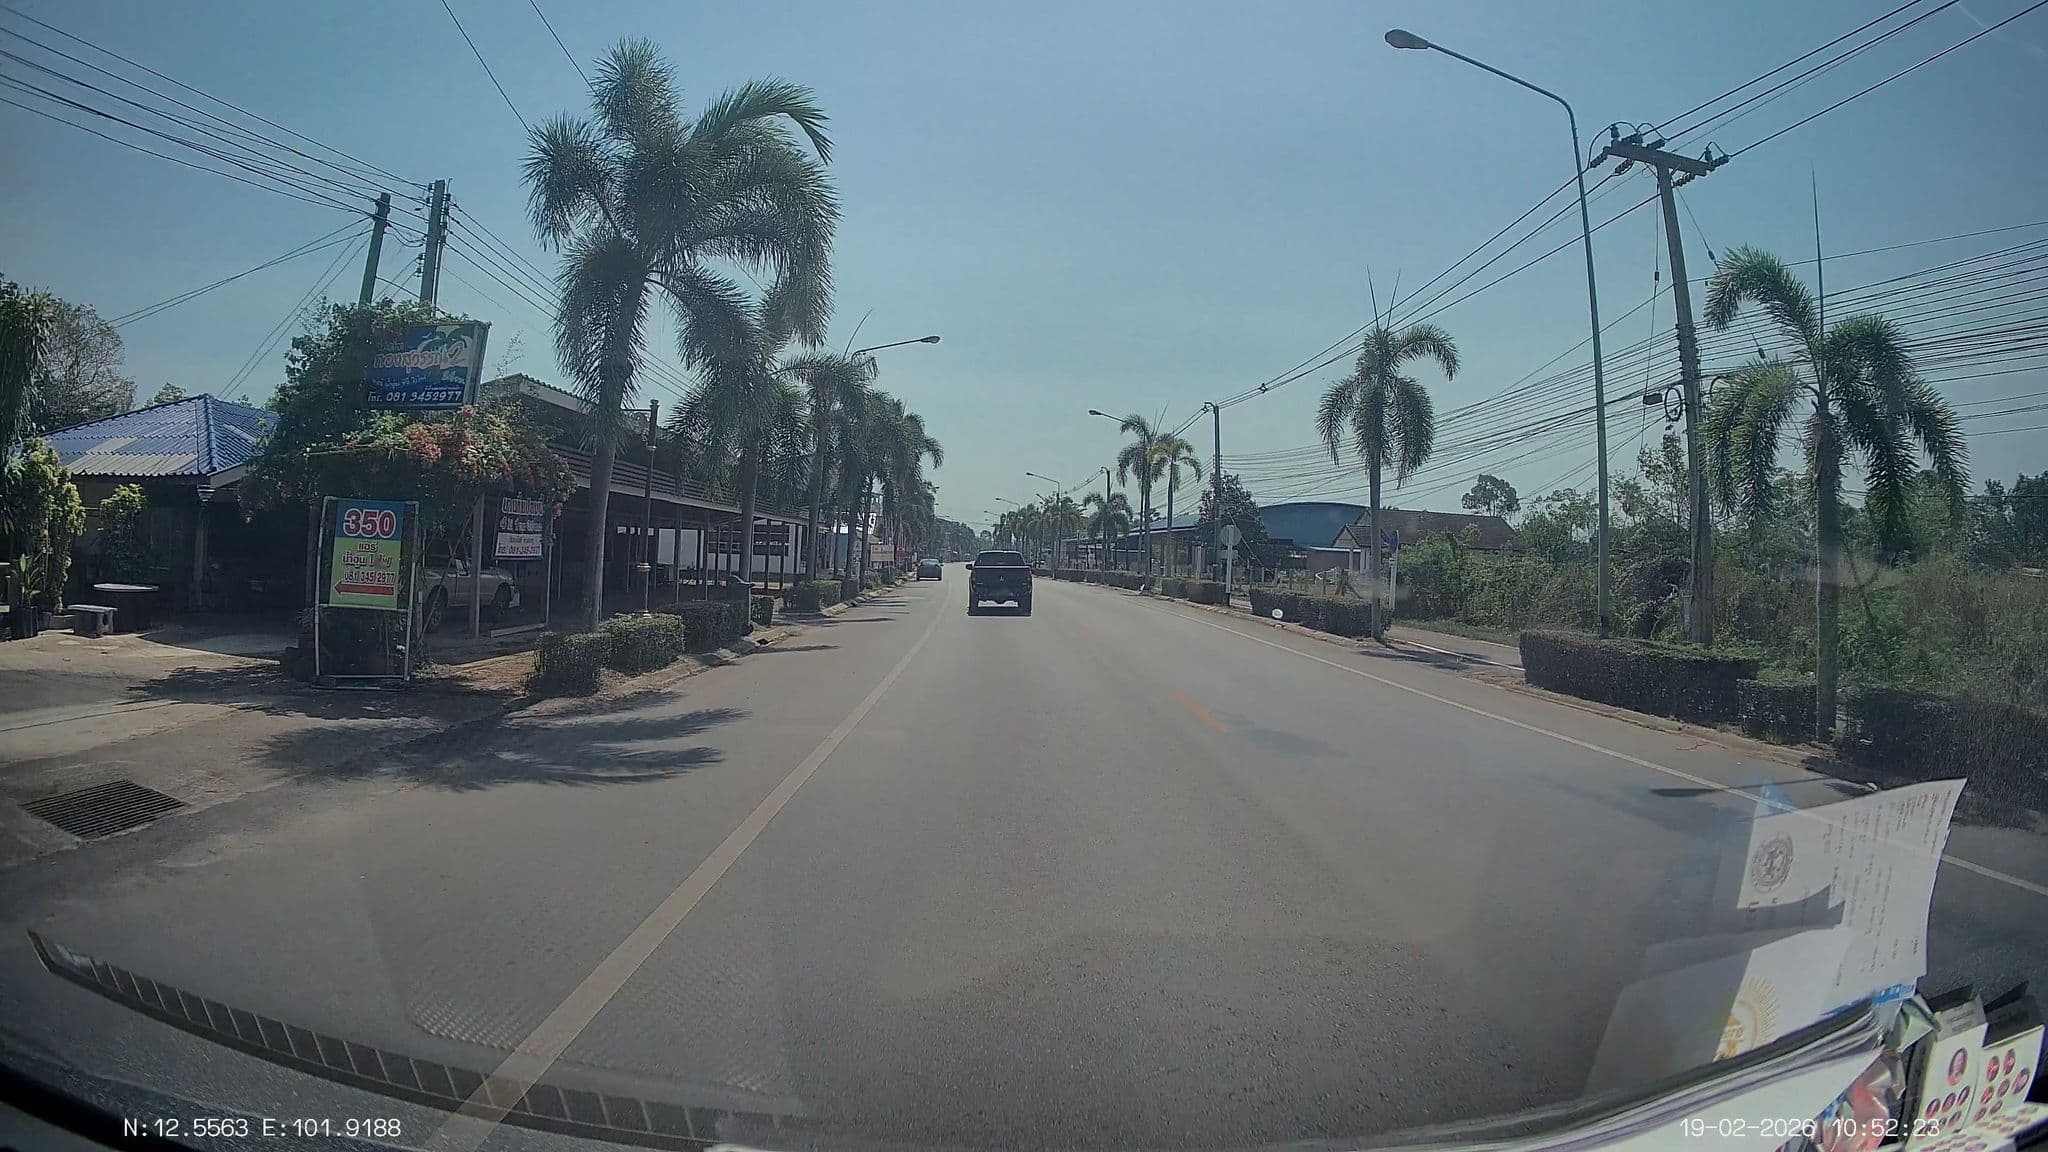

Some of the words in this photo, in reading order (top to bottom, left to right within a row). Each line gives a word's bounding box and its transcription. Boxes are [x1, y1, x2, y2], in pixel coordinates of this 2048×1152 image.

[386, 391, 407, 402] 081
[409, 390, 462, 402] 3452977
[343, 508, 396, 538] 350
[344, 571, 359, 583] 081
[360, 571, 375, 584] 345
[376, 572, 396, 585] 2977
